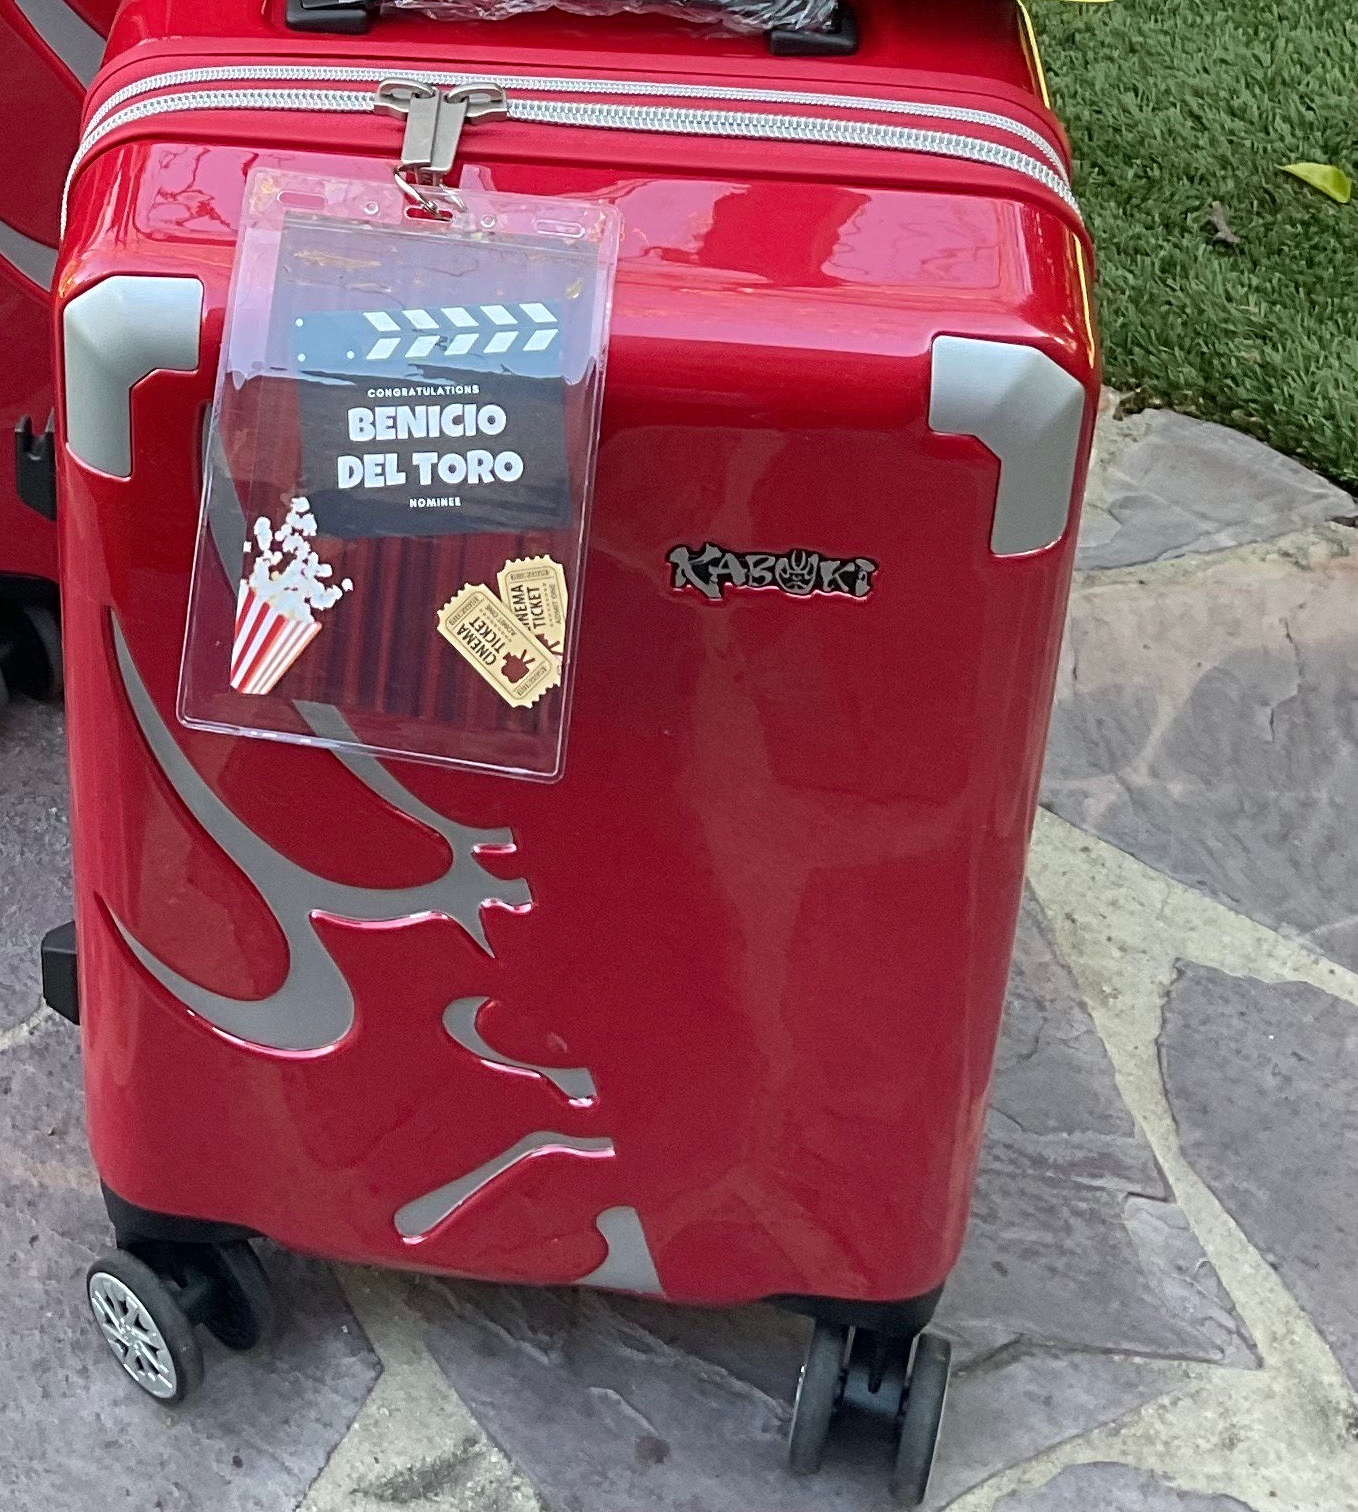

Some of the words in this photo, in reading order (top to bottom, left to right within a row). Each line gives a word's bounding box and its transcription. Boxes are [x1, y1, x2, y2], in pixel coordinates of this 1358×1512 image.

[367, 385, 480, 398] CONGRATULATIONS
[347, 403, 507, 441] BENICIO
[337, 453, 407, 489] DEL
[412, 449, 524, 486] TORO
[409, 497, 462, 508] NOMINEE
[526, 586, 547, 630] TICKET
[456, 622, 497, 666] CINEMA
[468, 616, 506, 655] TICKET
